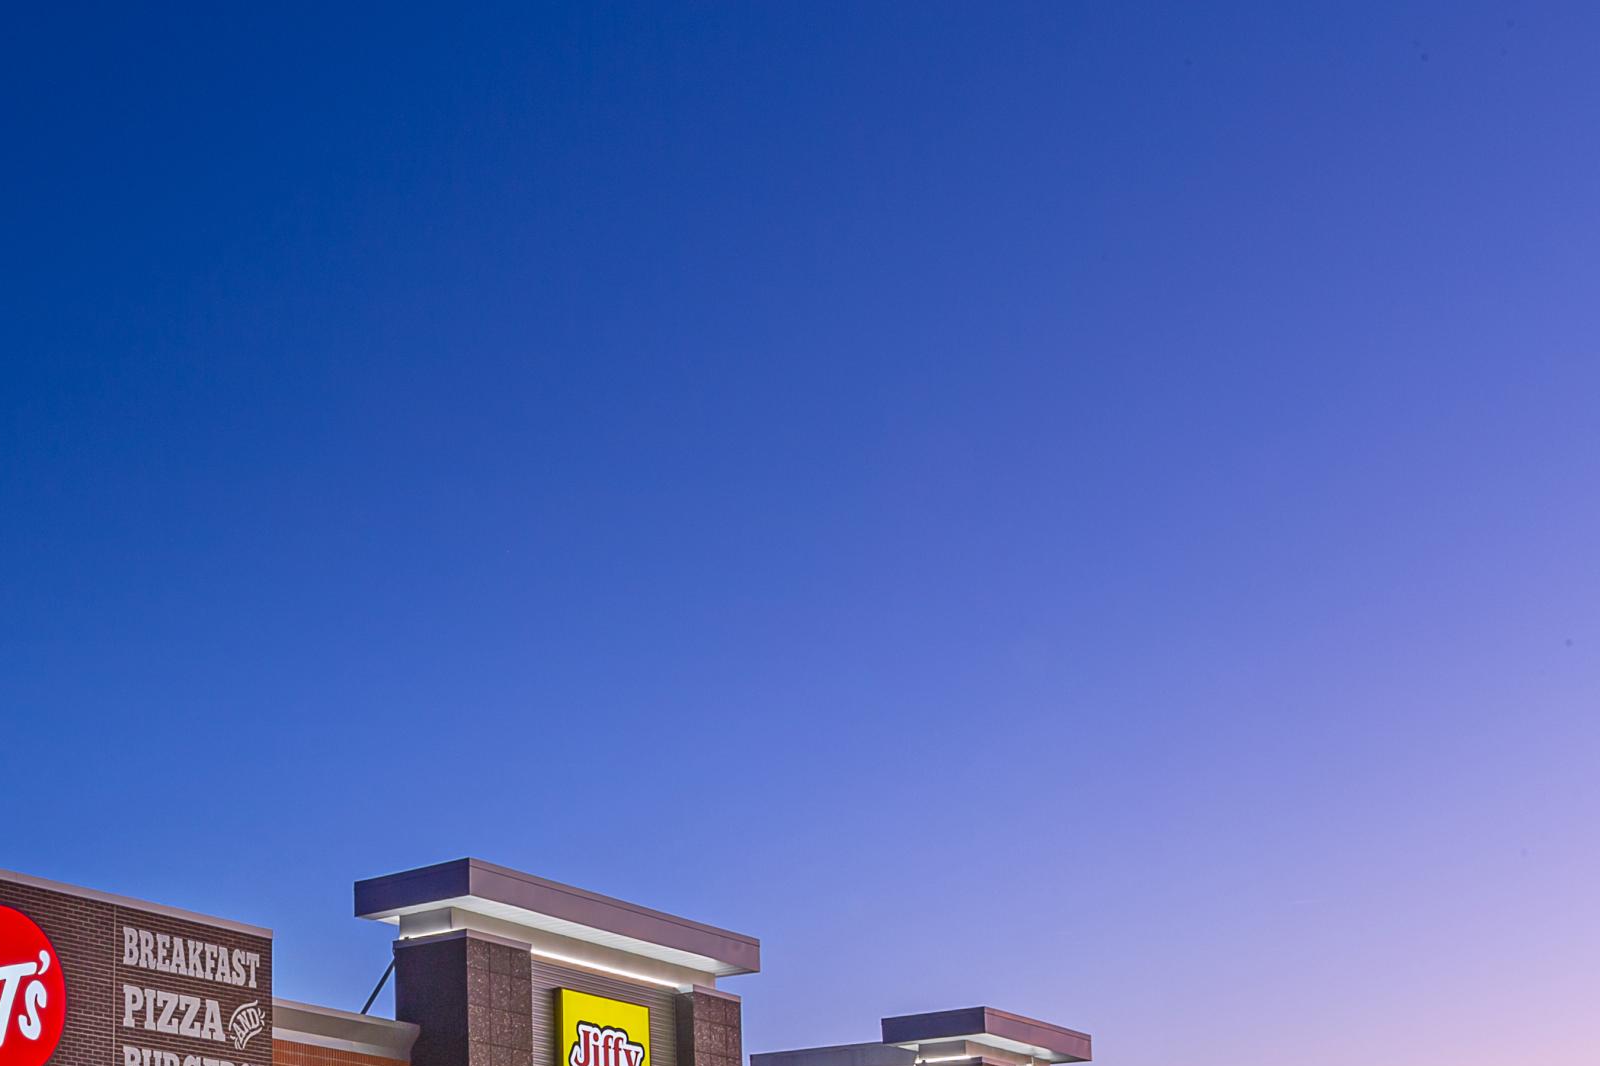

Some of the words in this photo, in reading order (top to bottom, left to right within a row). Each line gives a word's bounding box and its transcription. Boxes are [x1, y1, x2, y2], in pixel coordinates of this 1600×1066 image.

[123, 926, 260, 988] BREAKFAST
[123, 984, 225, 1042] PIZZA
[235, 1010, 260, 1040] AND
